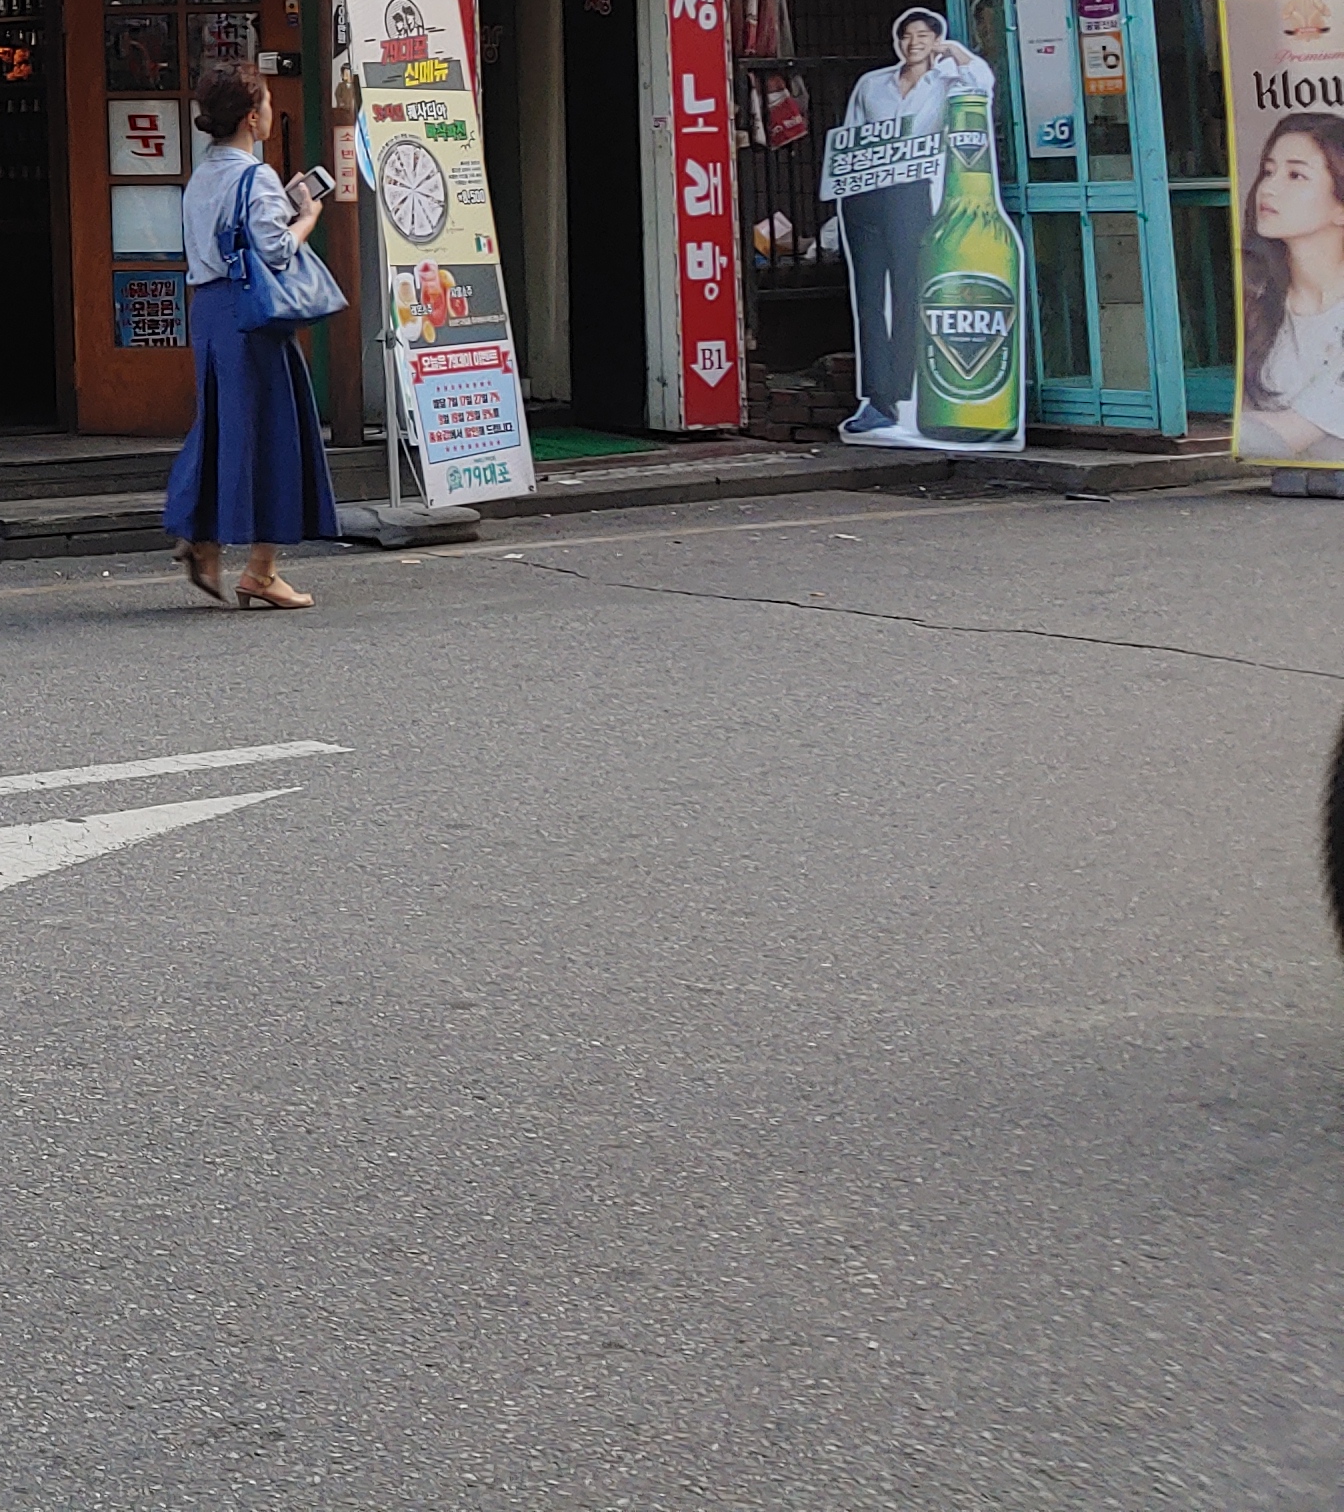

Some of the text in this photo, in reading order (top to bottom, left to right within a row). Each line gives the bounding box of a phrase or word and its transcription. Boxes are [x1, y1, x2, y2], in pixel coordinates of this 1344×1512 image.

[380, 34, 429, 66] 79대포
[404, 58, 449, 86] 신메뉴
[834, 119, 902, 149] 이 맛이
[947, 131, 989, 147] TERRA
[1042, 120, 1070, 141] 5G
[926, 310, 1008, 336] TERRA
[700, 346, 725, 372] B1
[463, 463, 512, 489] 79대포
